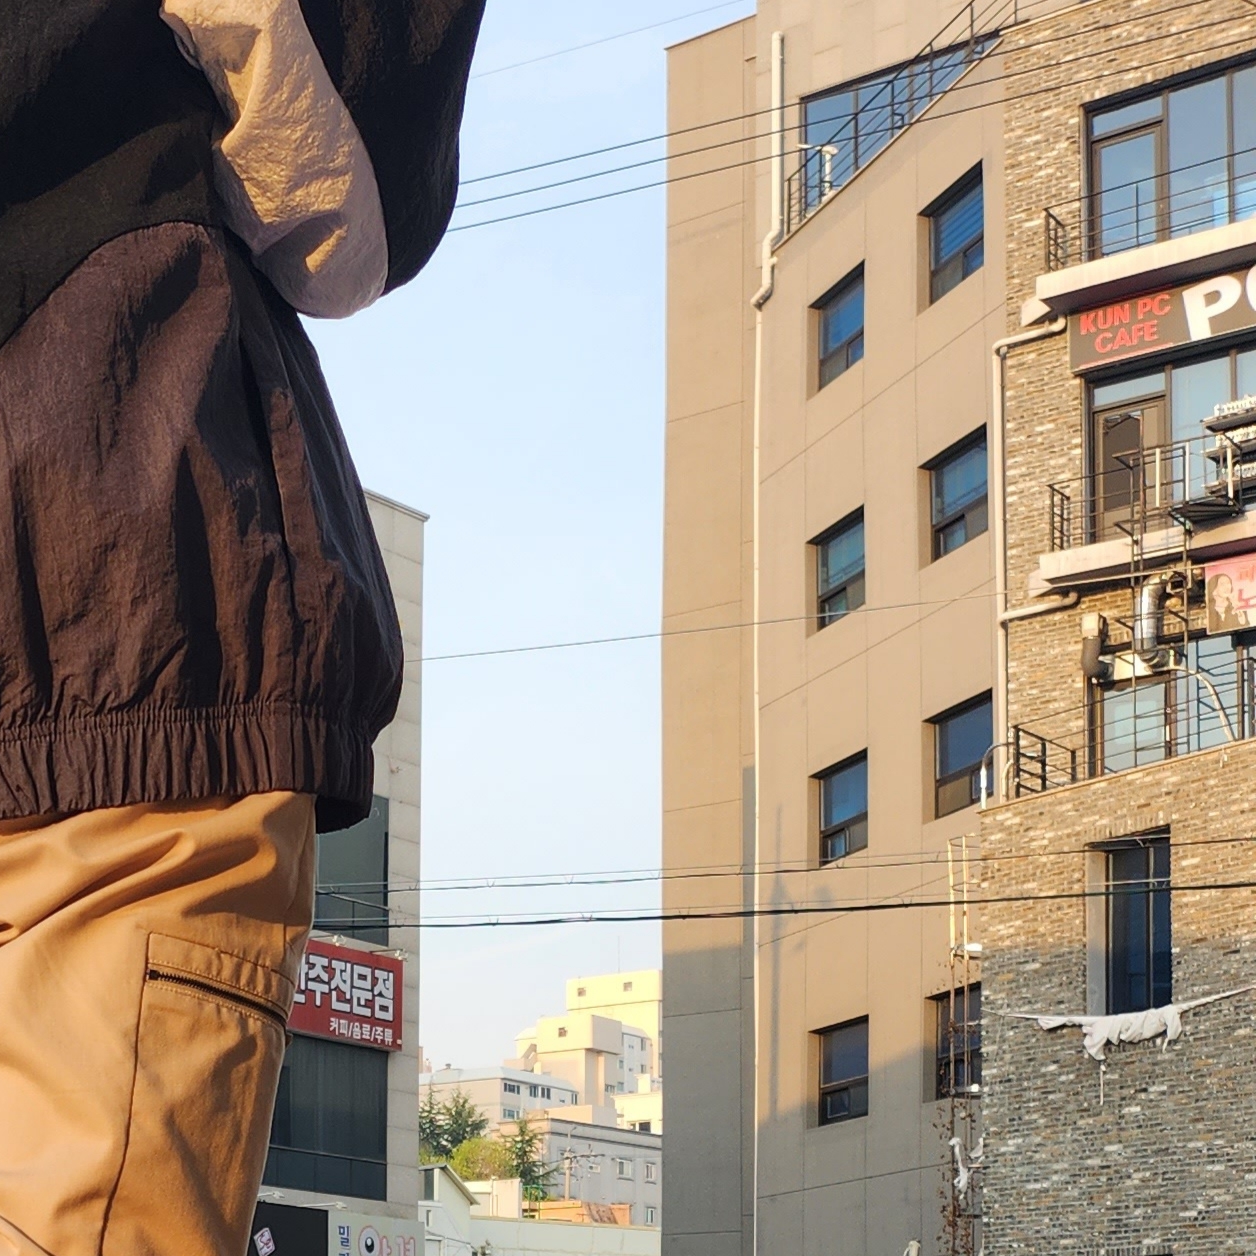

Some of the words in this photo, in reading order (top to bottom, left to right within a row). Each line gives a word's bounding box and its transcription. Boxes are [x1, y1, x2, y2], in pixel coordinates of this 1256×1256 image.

[1079, 303, 1130, 336] KUN
[1137, 293, 1172, 320] PC
[1182, 264, 1256, 342] P
[1095, 319, 1159, 354] CAFE
[329, 1017, 393, 1046] 커피/음료/주류
